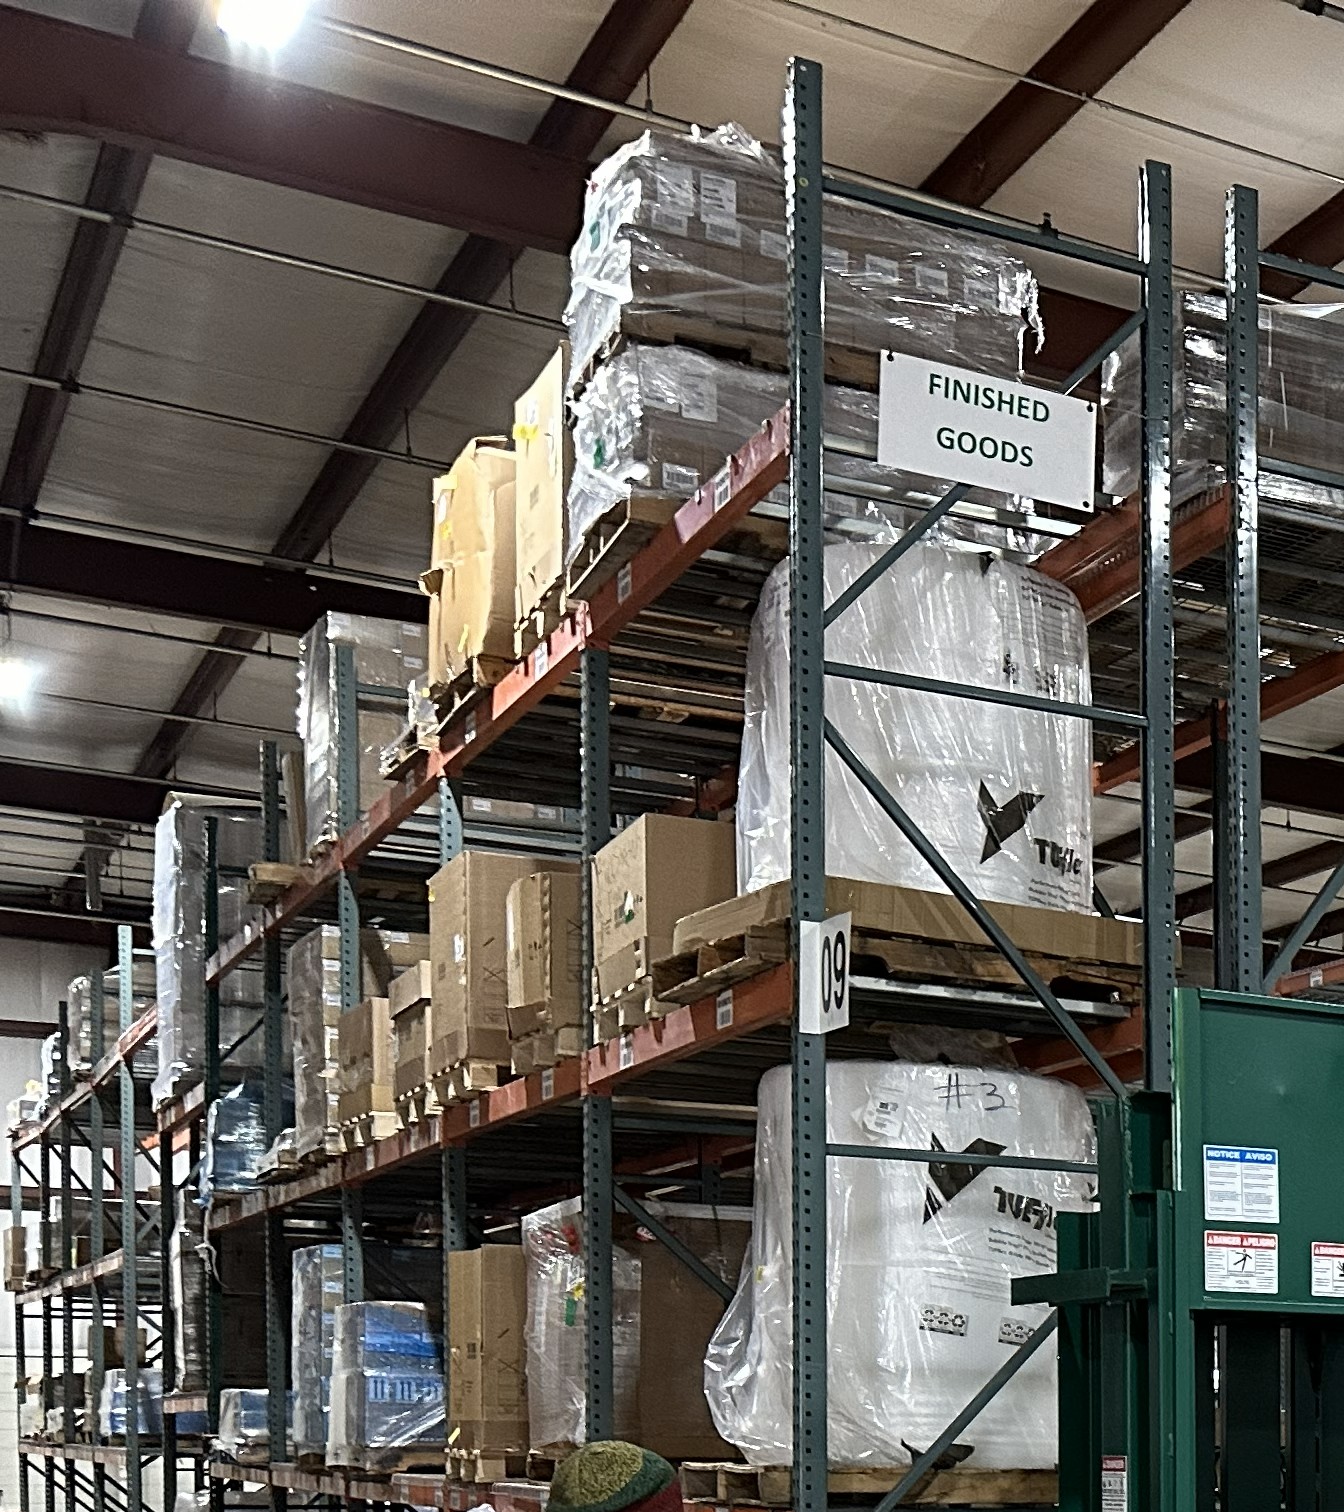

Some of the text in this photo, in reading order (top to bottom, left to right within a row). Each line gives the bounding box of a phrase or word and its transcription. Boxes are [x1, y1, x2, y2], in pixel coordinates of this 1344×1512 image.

[929, 373, 1050, 422] FINISHED
[936, 427, 1034, 467] GOODS
[821, 930, 845, 1013] 09
[1208, 1150, 1241, 1159] NOTICE
[1245, 1152, 1273, 1161] AVISO
